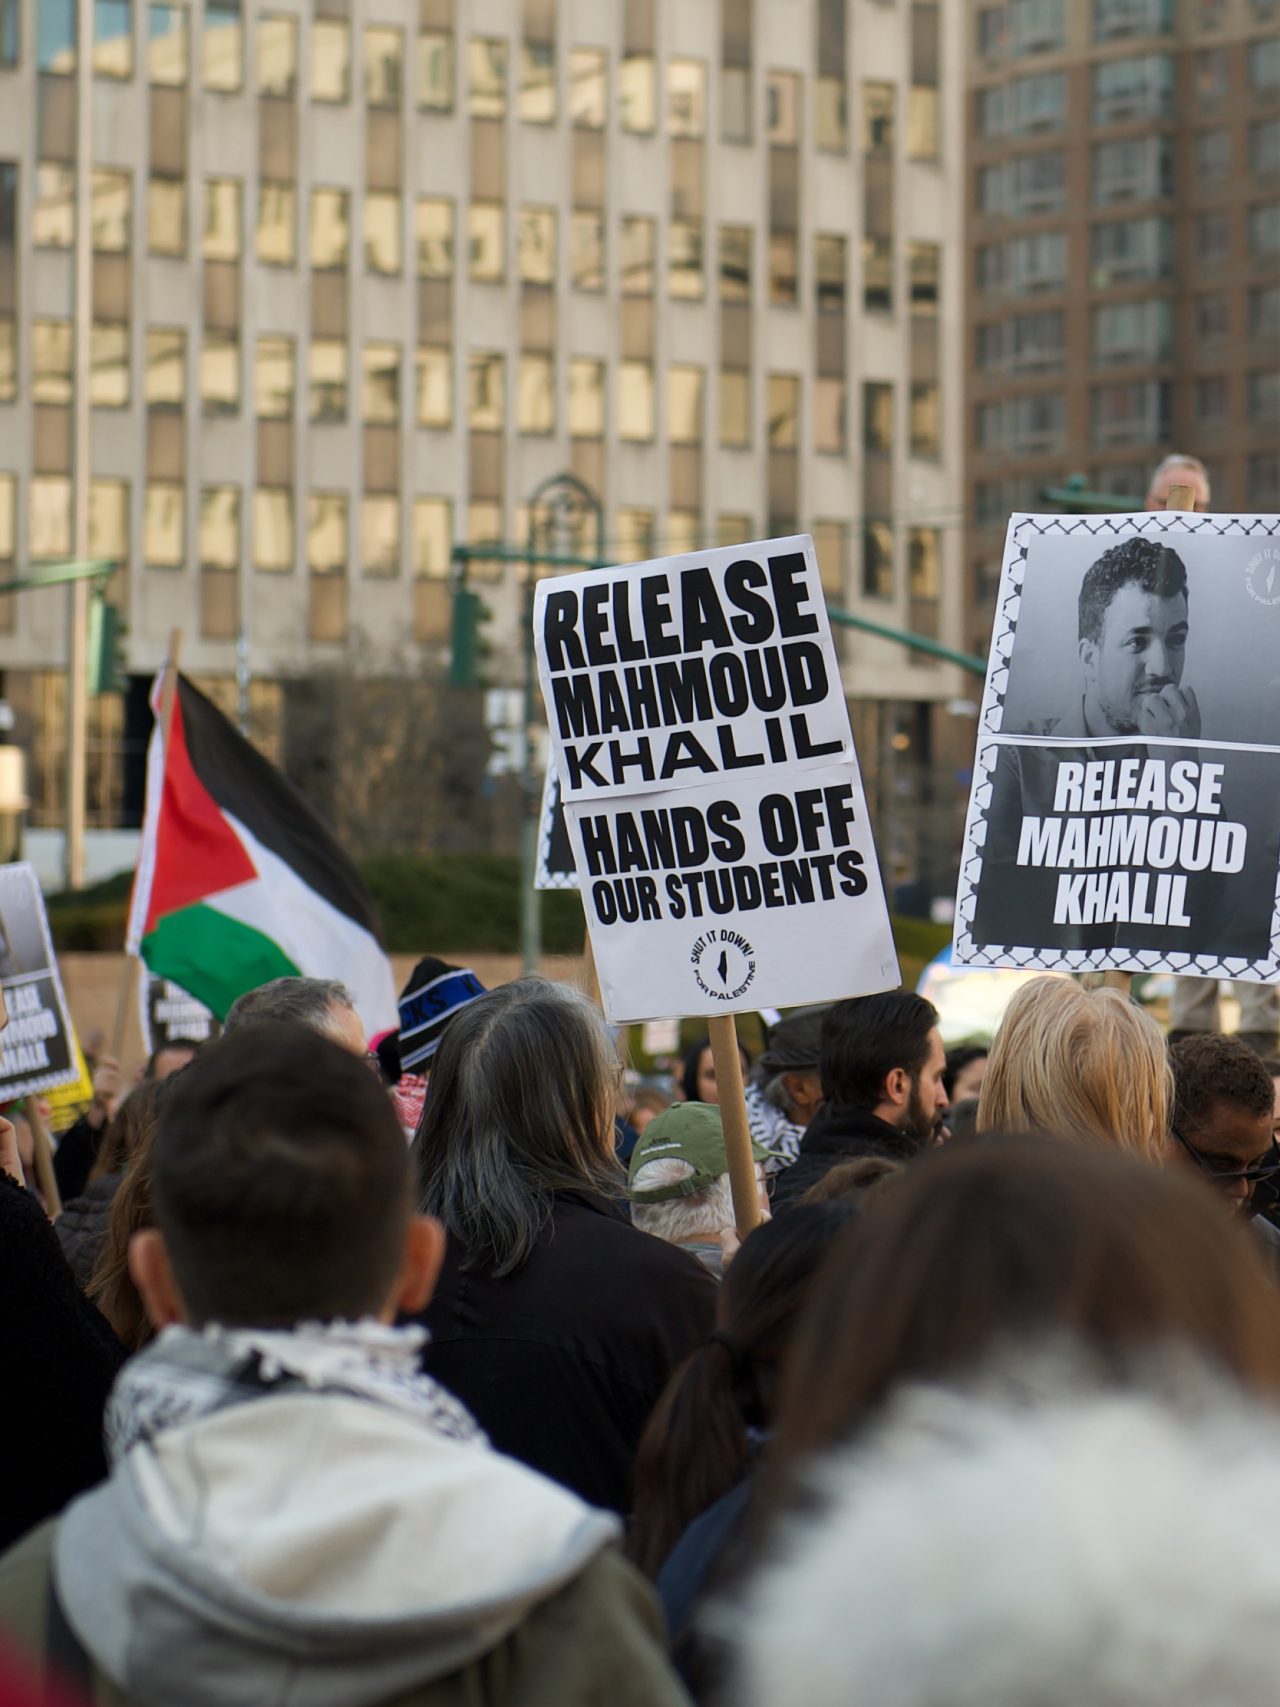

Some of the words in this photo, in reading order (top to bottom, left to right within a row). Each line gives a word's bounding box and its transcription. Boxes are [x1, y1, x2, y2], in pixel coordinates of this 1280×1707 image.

[544, 552, 819, 671] RELEASE
[551, 641, 829, 740] MAHMOUD
[563, 713, 843, 790] KHALIL
[1053, 759, 1225, 815] RELEASE
[579, 800, 745, 876] HANDS
[759, 783, 855, 858] OFF
[1017, 814, 1247, 874] MAHMOUD
[592, 875, 662, 926] OUR
[665, 850, 868, 920] STUDENTS
[1053, 871, 1191, 927] KHALIL
[691, 936, 707, 964] SHUT
[706, 930, 716, 944] IT
[720, 930, 754, 957] DOWN!
[694, 970, 709, 994] FOR
[710, 960, 756, 1000] PALESTINE
